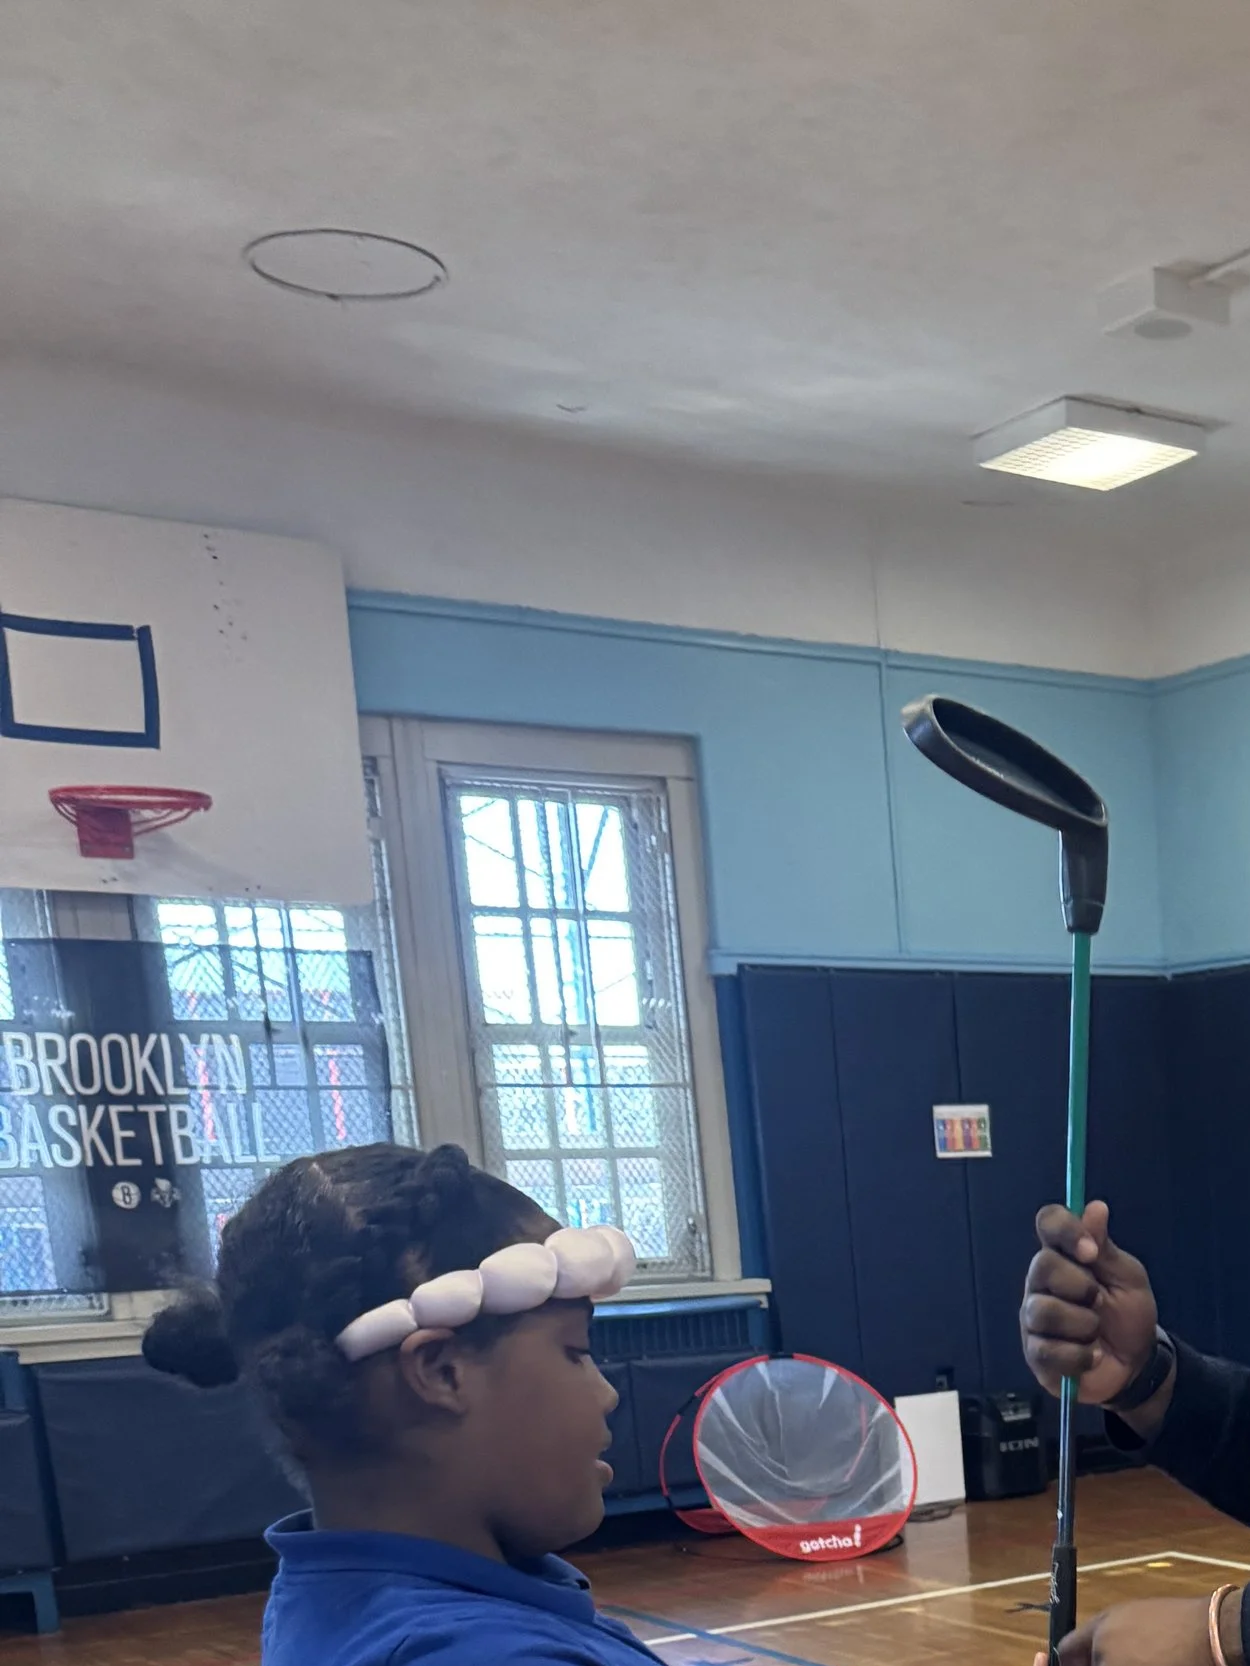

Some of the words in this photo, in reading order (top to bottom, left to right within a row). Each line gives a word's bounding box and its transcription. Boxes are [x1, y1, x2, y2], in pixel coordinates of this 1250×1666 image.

[2, 1031, 247, 1096] BROOKLYN
[0, 1101, 281, 1169] BASKETBALL
[799, 1523, 862, 1554] gotcha!
